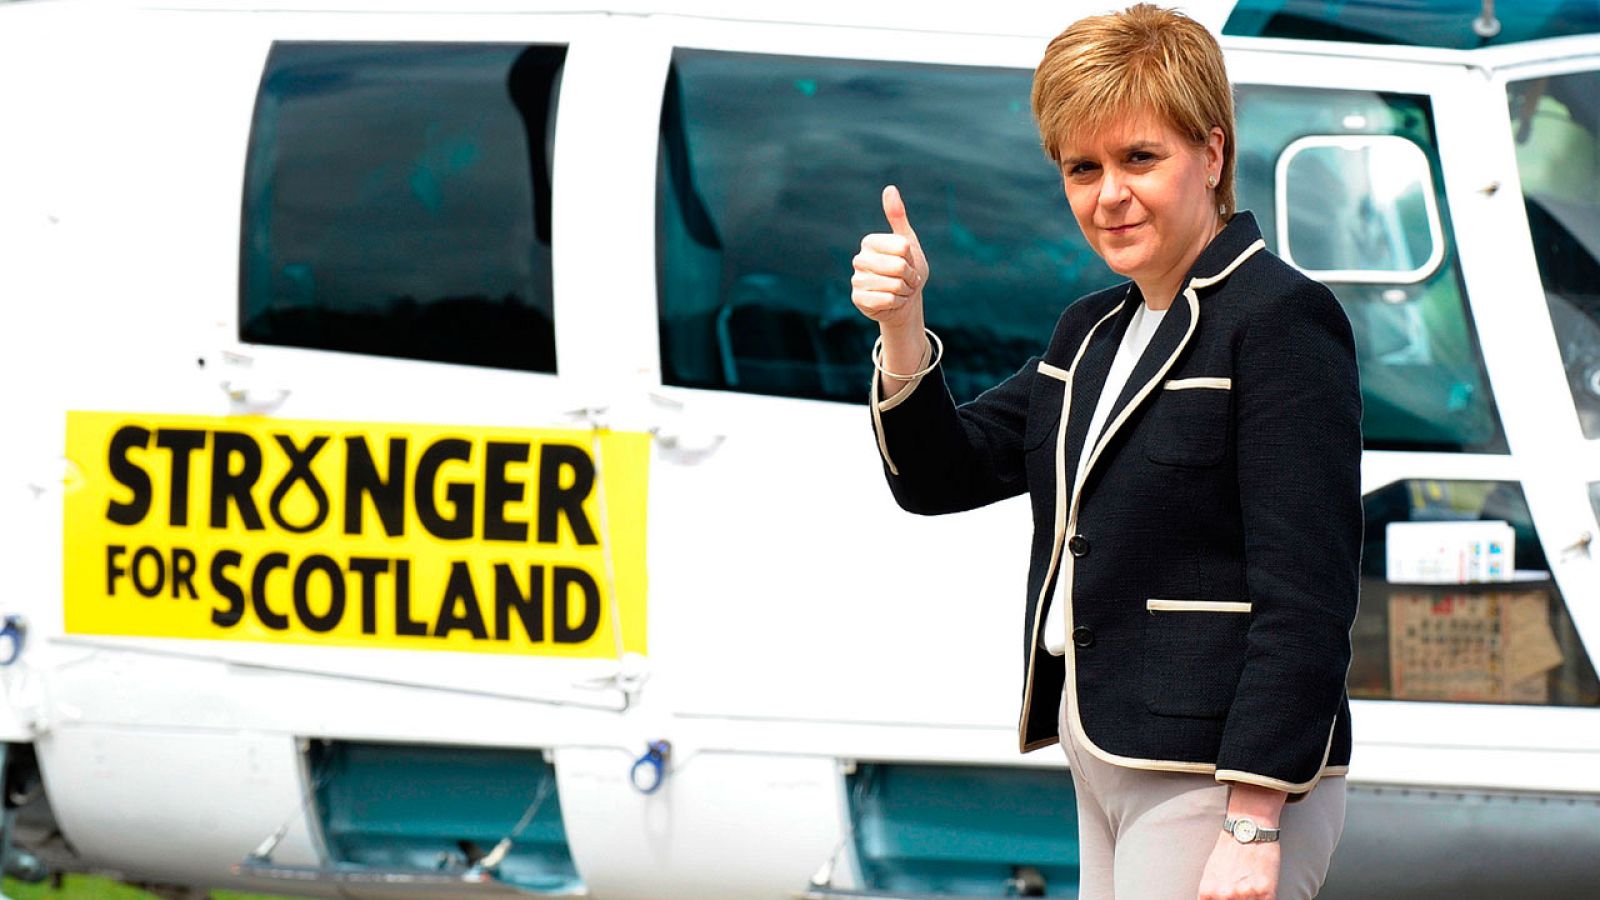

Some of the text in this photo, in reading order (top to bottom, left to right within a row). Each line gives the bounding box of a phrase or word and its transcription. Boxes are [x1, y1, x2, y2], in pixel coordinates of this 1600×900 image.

[106, 425, 598, 546] STRONGER
[107, 545, 601, 644] FOR SCOTLAND
